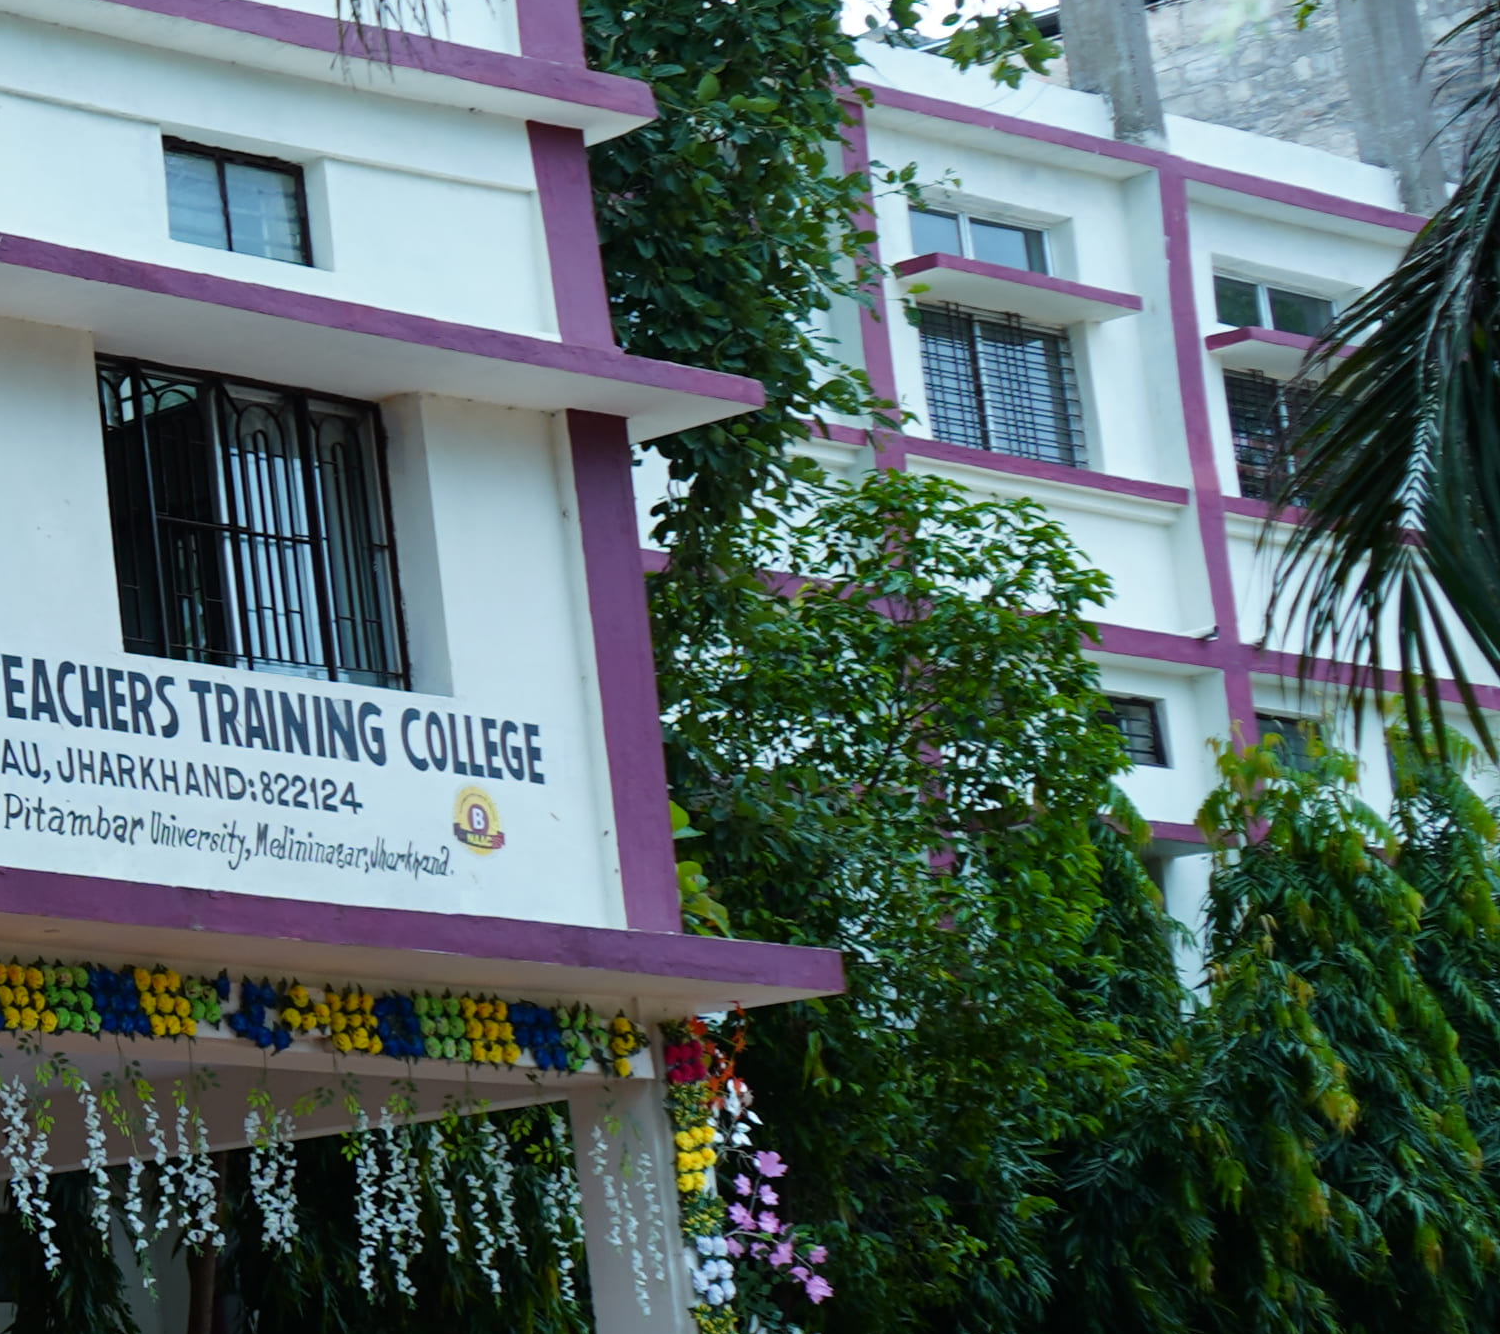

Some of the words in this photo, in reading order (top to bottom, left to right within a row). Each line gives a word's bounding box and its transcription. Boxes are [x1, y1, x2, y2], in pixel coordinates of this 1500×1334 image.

[188, 678, 388, 767] TRAINING
[400, 707, 547, 785] COLLEGE
[3, 792, 145, 845] Pitambar
[150, 810, 251, 871] University,
